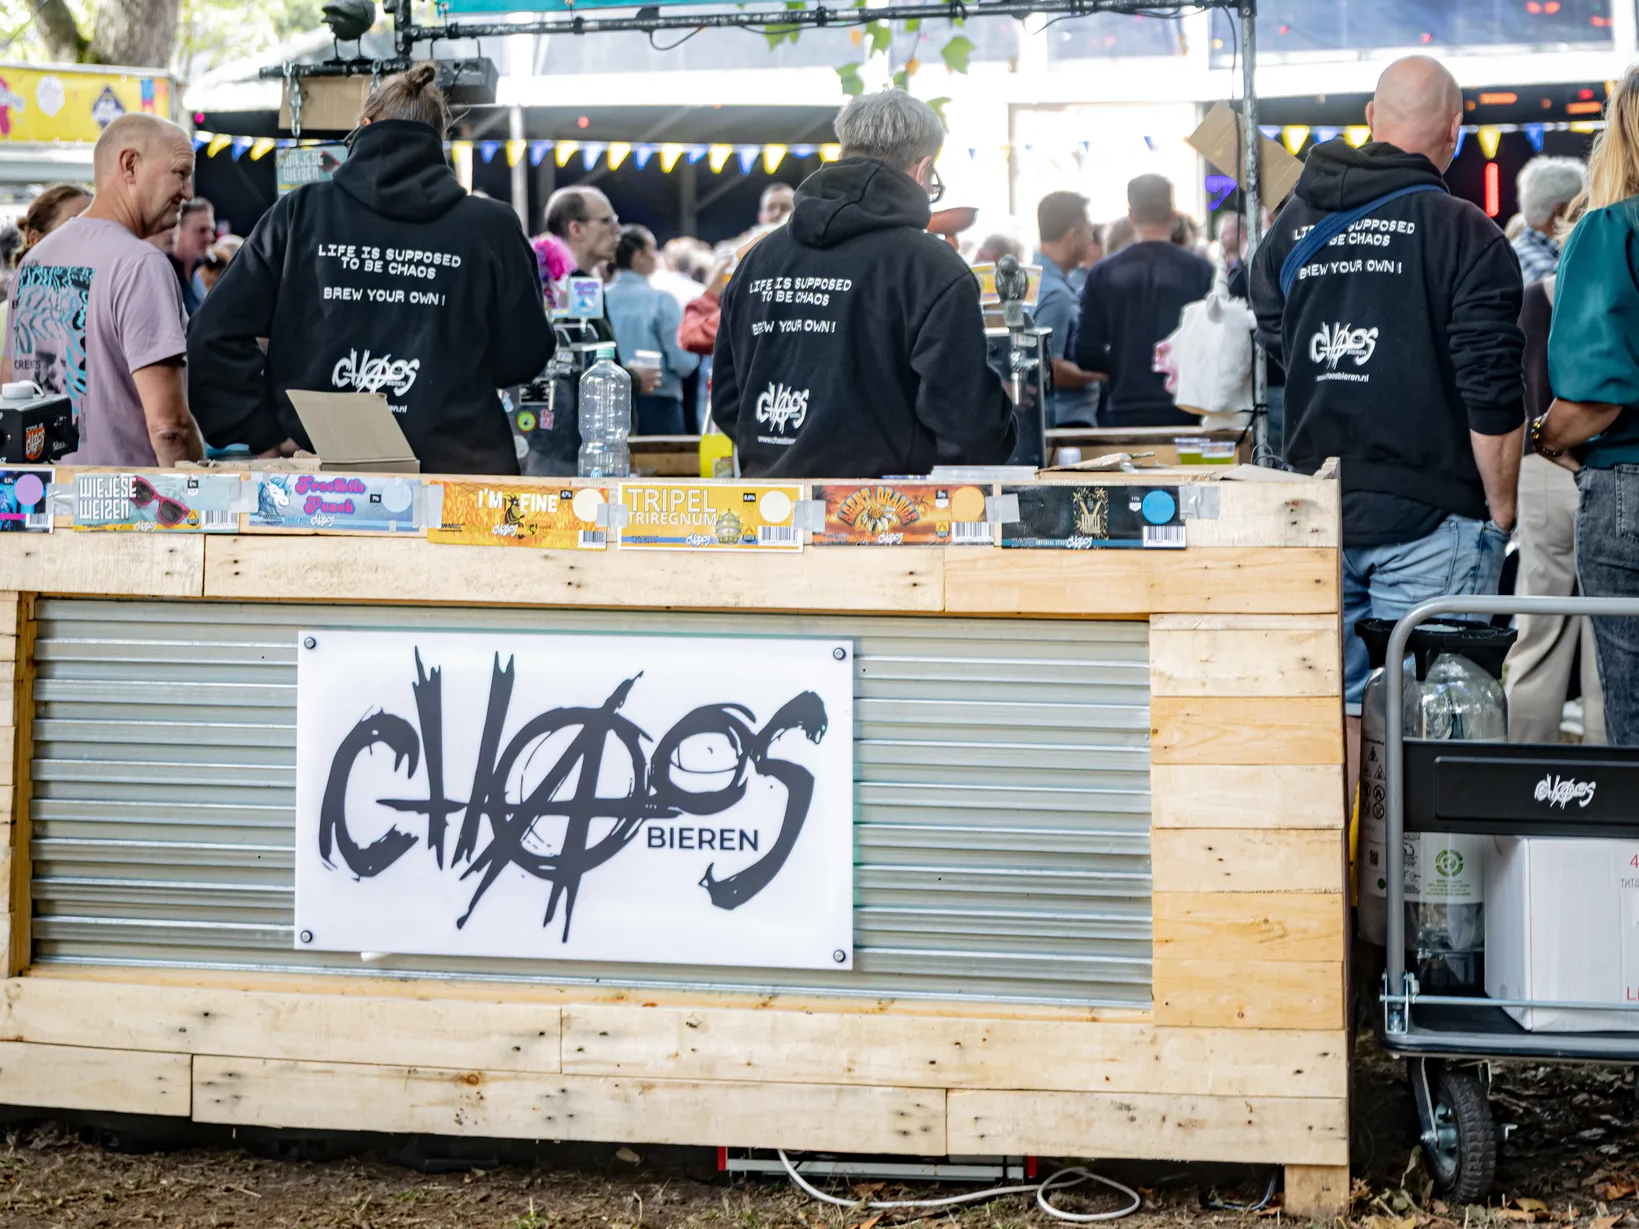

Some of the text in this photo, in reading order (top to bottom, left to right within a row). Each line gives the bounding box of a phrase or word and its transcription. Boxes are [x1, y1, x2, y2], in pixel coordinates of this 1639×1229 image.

[1348, 218, 1416, 235] SUPPOSED
[1348, 232, 1391, 247] CHAOS
[318, 244, 462, 268] LIFE IS SUPPOSED
[1330, 259, 1362, 274] YOUR
[341, 257, 437, 280] TO BE CHAOS
[323, 287, 363, 301] BREW
[367, 289, 405, 303] YOUR
[749, 277, 852, 294] LIFE IS SUPPOSED
[761, 290, 830, 307] TO BE CHAOS
[779, 319, 802, 333] YOUR
[1309, 321, 1379, 370] CHAOS
[331, 347, 420, 397] CHAOS
[756, 381, 810, 434] CHAOS
[79, 477, 137, 498] WIEJESE
[79, 499, 130, 520] WEIZEN
[303, 495, 355, 514] Punch
[478, 488, 558, 514] I'M FINE
[626, 488, 717, 513] TRIPEL
[837, 485, 920, 527] AGENT ORANGE
[627, 511, 718, 526] TRIREGNUM
[319, 645, 828, 943] CHAOS
[646, 827, 760, 852] BIEREN
